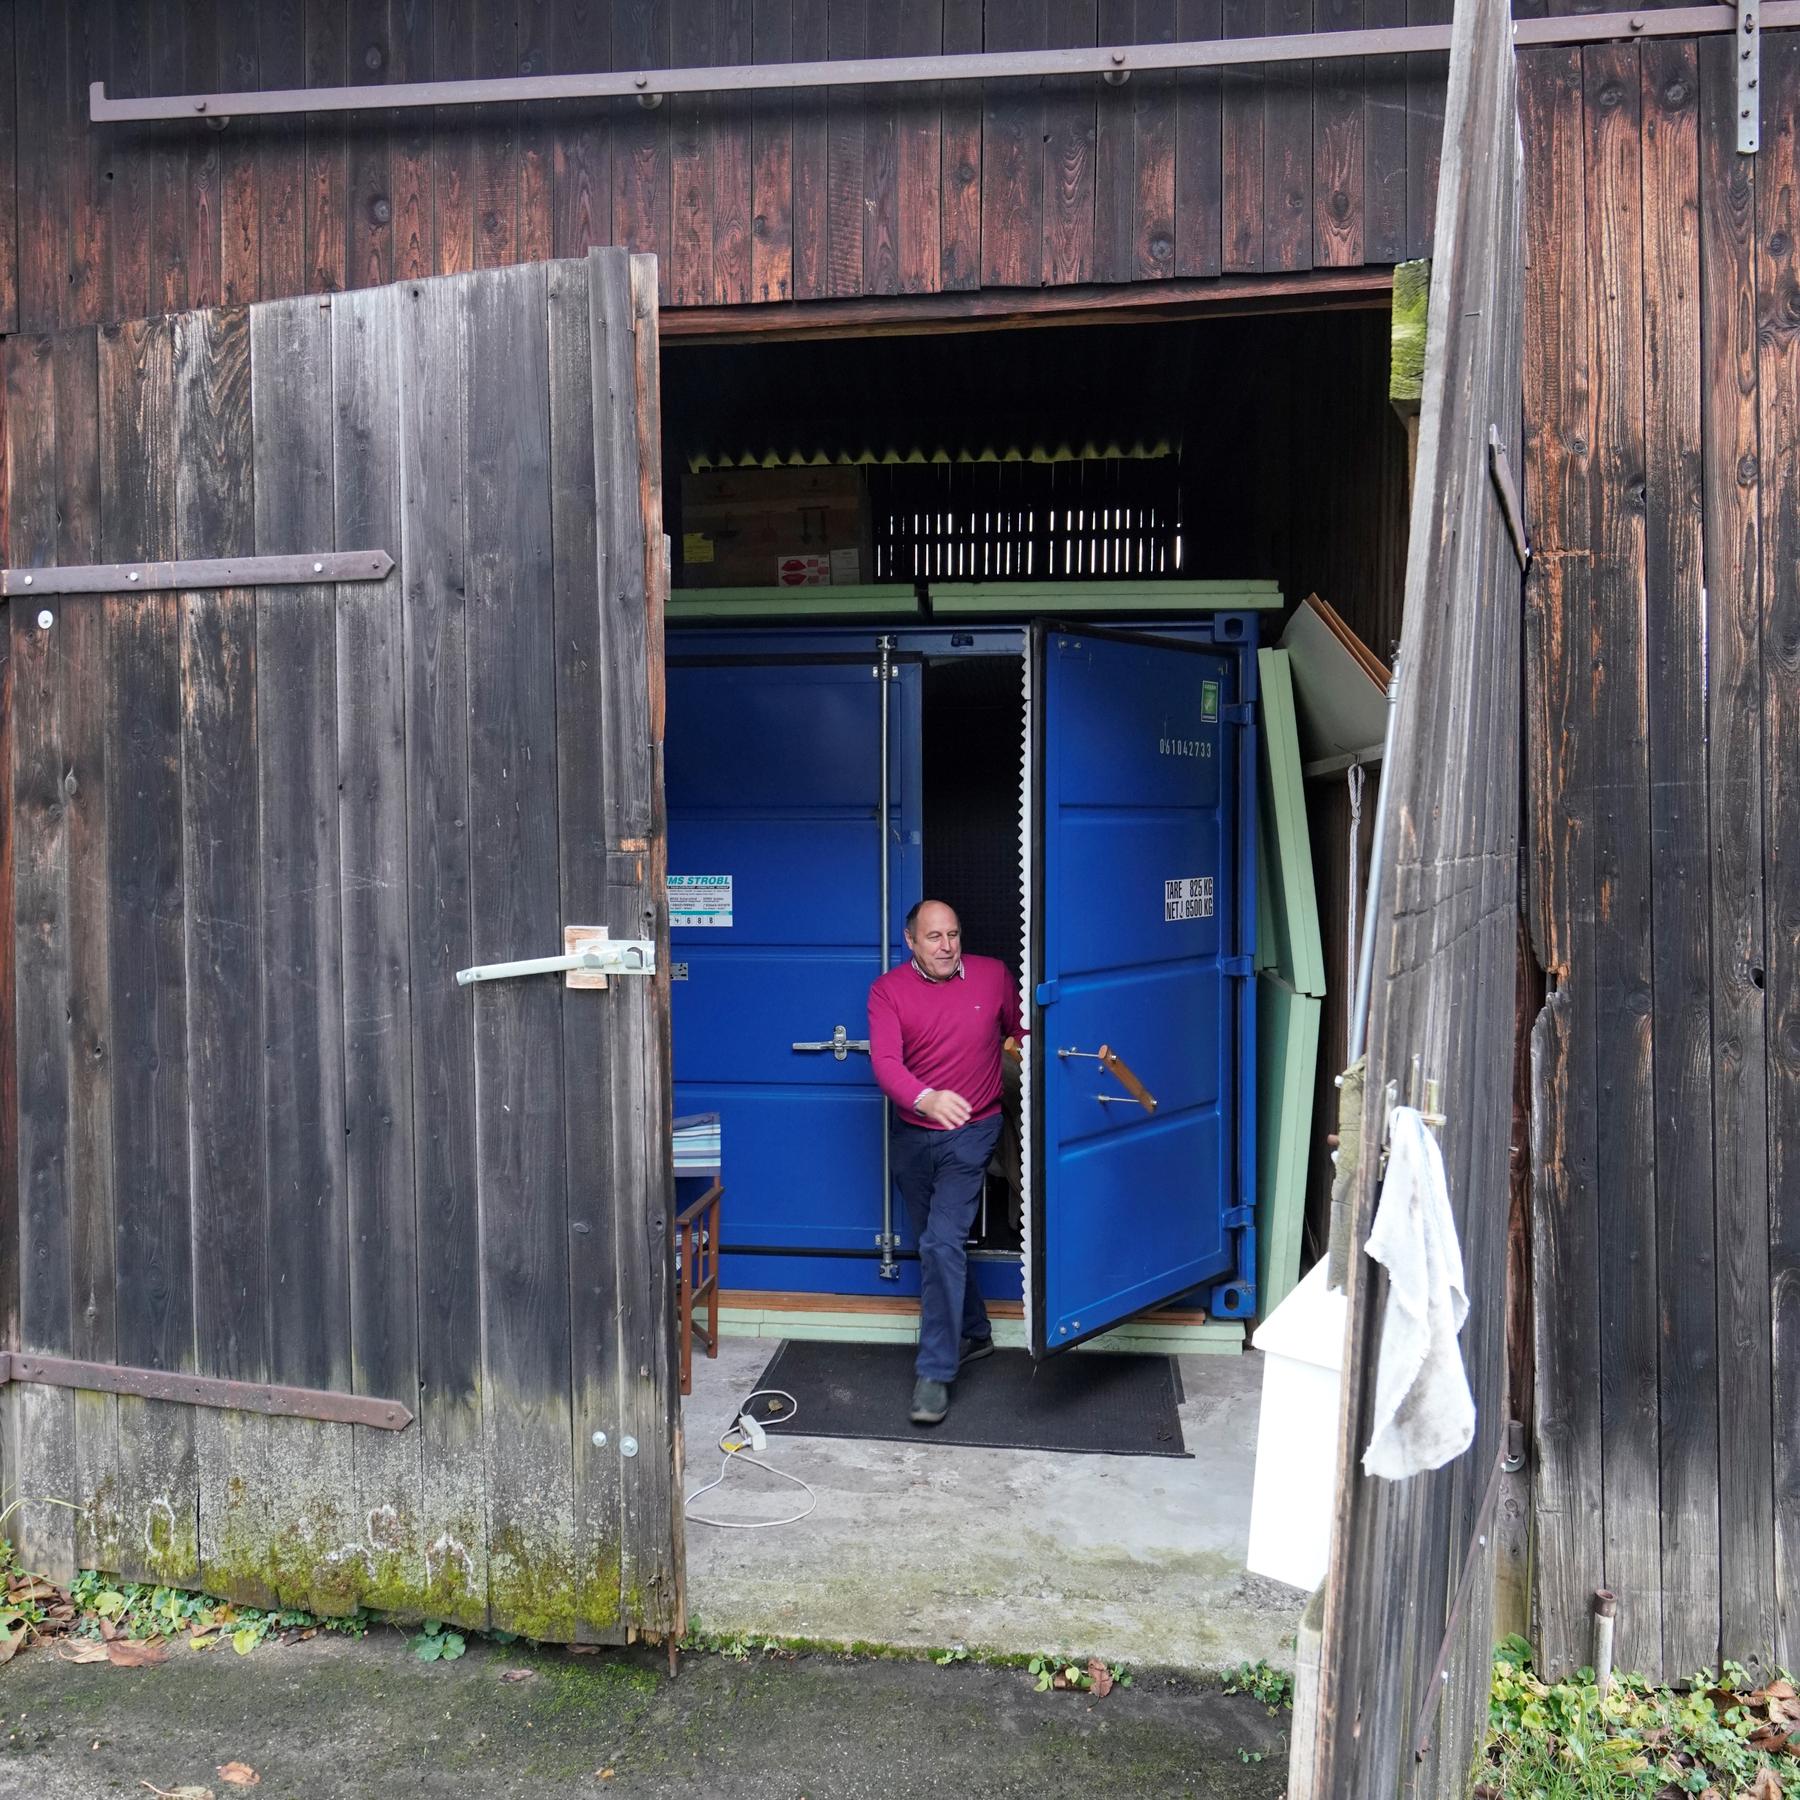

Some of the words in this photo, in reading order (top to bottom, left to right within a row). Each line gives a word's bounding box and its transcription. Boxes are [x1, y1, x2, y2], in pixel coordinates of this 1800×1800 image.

[687, 876, 730, 885] STROBL
[1166, 881, 1182, 899] TARE
[1189, 879, 1202, 897] 825
[1203, 878, 1213, 896] KG
[1185, 899, 1202, 917] 6500
[1203, 898, 1213, 916] KG
